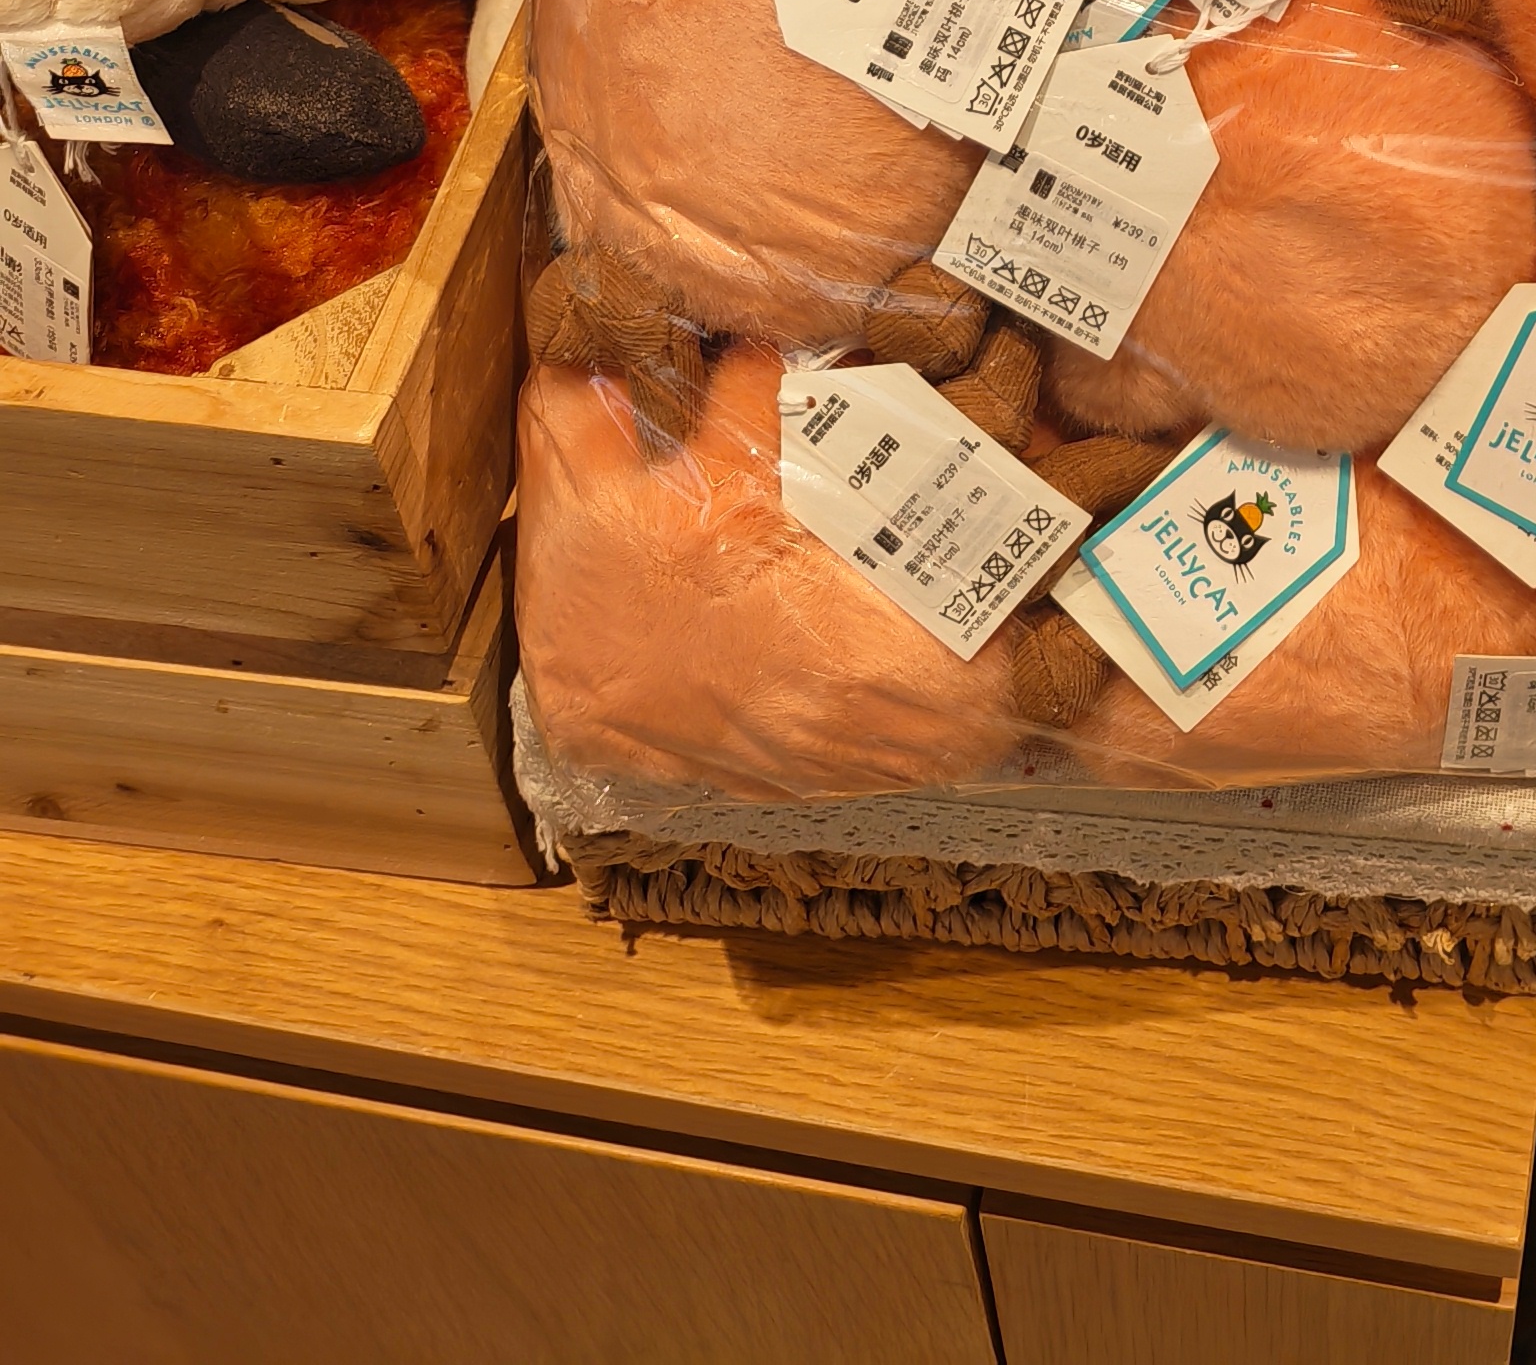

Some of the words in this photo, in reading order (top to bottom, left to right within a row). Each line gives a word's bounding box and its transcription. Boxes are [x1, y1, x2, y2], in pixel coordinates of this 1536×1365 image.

[24, 45, 120, 70] AMUSEABLES
[41, 96, 144, 113] JELLYCAT
[75, 115, 133, 125] LONDON
[1075, 124, 1143, 173] 0岁适用
[3, 208, 48, 249] 0岁适用
[848, 433, 901, 491] 0岁适用
[1227, 456, 1304, 556] AMUSEABLES
[1140, 510, 1238, 624] JELLYCAT
[1154, 564, 1187, 606] LONDON
